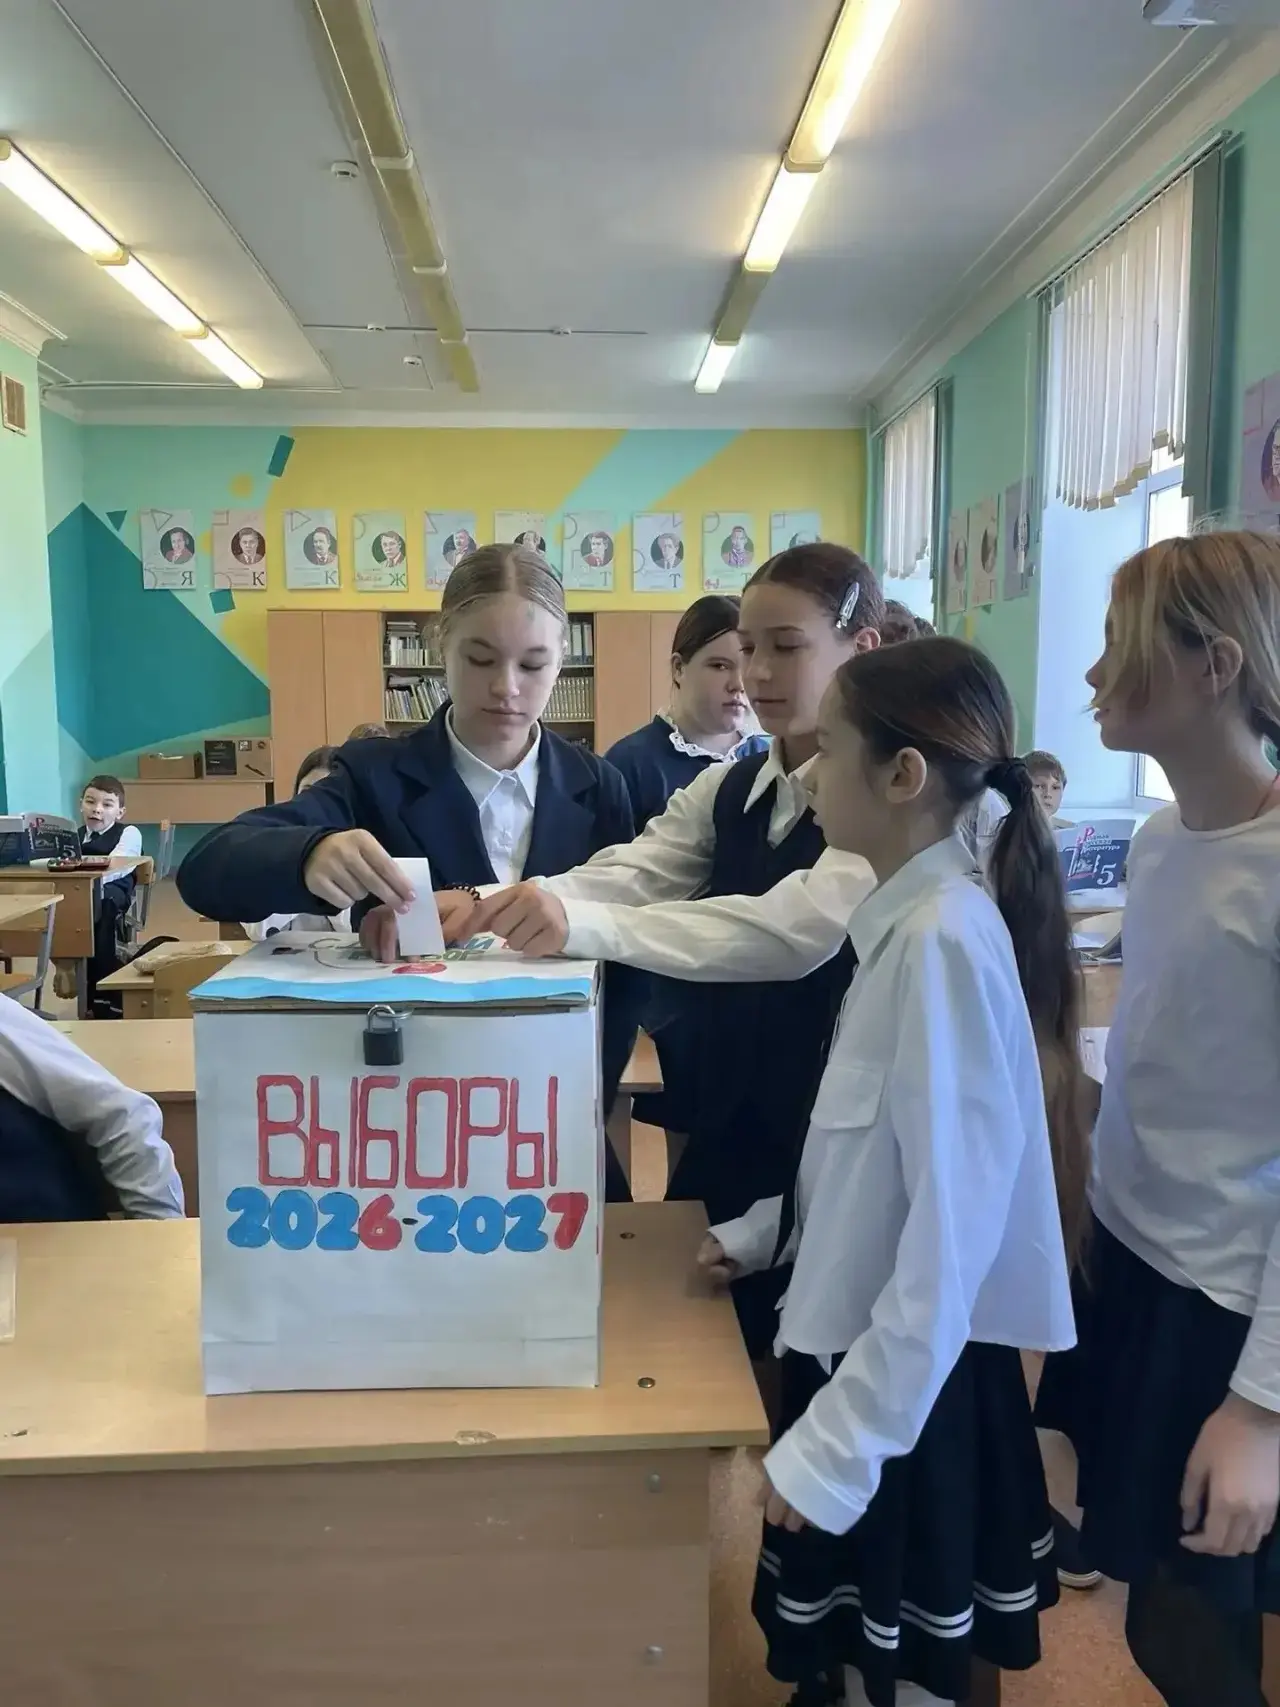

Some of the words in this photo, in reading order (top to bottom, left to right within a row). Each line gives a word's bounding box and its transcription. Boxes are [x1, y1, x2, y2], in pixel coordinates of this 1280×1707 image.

[181, 570, 194, 586] Я
[252, 571, 265, 586] К
[389, 572, 406, 588] Ж
[63, 844, 77, 858] 5
[1096, 863, 1117, 886] 5
[256, 1074, 559, 1189] ВЫБОРЫ
[225, 1186, 589, 1255] 2026-2027
